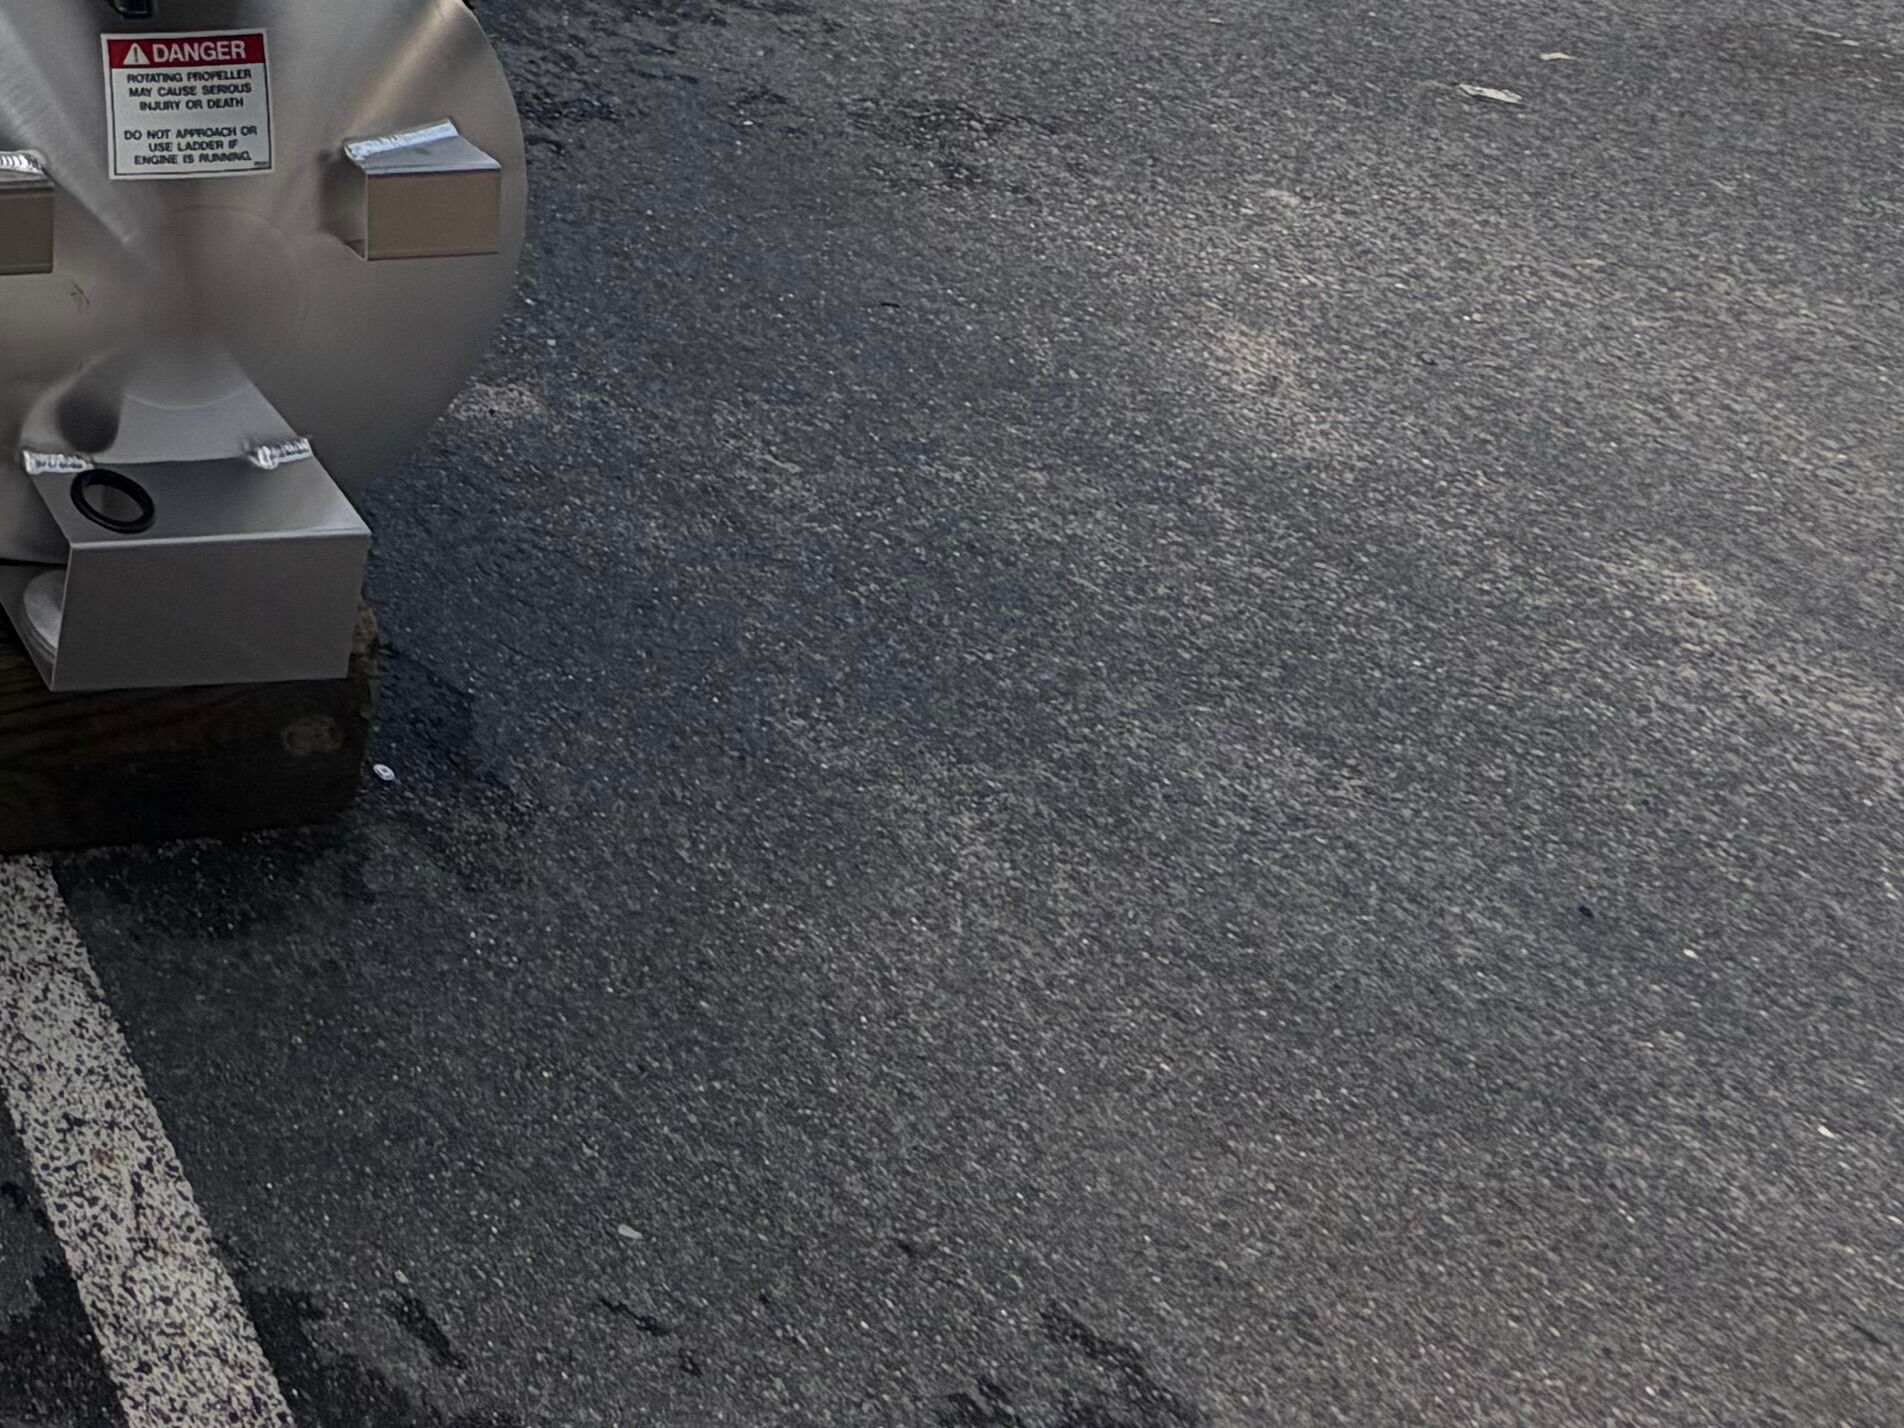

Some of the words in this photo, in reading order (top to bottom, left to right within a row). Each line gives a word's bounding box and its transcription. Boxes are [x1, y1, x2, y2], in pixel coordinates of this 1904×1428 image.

[152, 40, 246, 63] DANGER
[127, 72, 183, 83] ROTATING
[187, 69, 252, 81] PROPELLER
[129, 87, 152, 97] MAY
[157, 85, 197, 97] CAUSE
[202, 83, 252, 95] SERIOUS
[139, 101, 181, 111] INJURY
[185, 100, 203, 110] OR
[207, 97, 244, 109] DEATH
[124, 130, 142, 140] DO
[146, 129, 170, 139] NOT
[176, 127, 237, 139] APPROACH
[240, 125, 258, 135] OR
[149, 142, 173, 152] USE
[178, 140, 224, 151] LADDER
[228, 139, 239, 149] IF
[135, 155, 178, 165] ENGINE
[183, 154, 194, 163] IS
